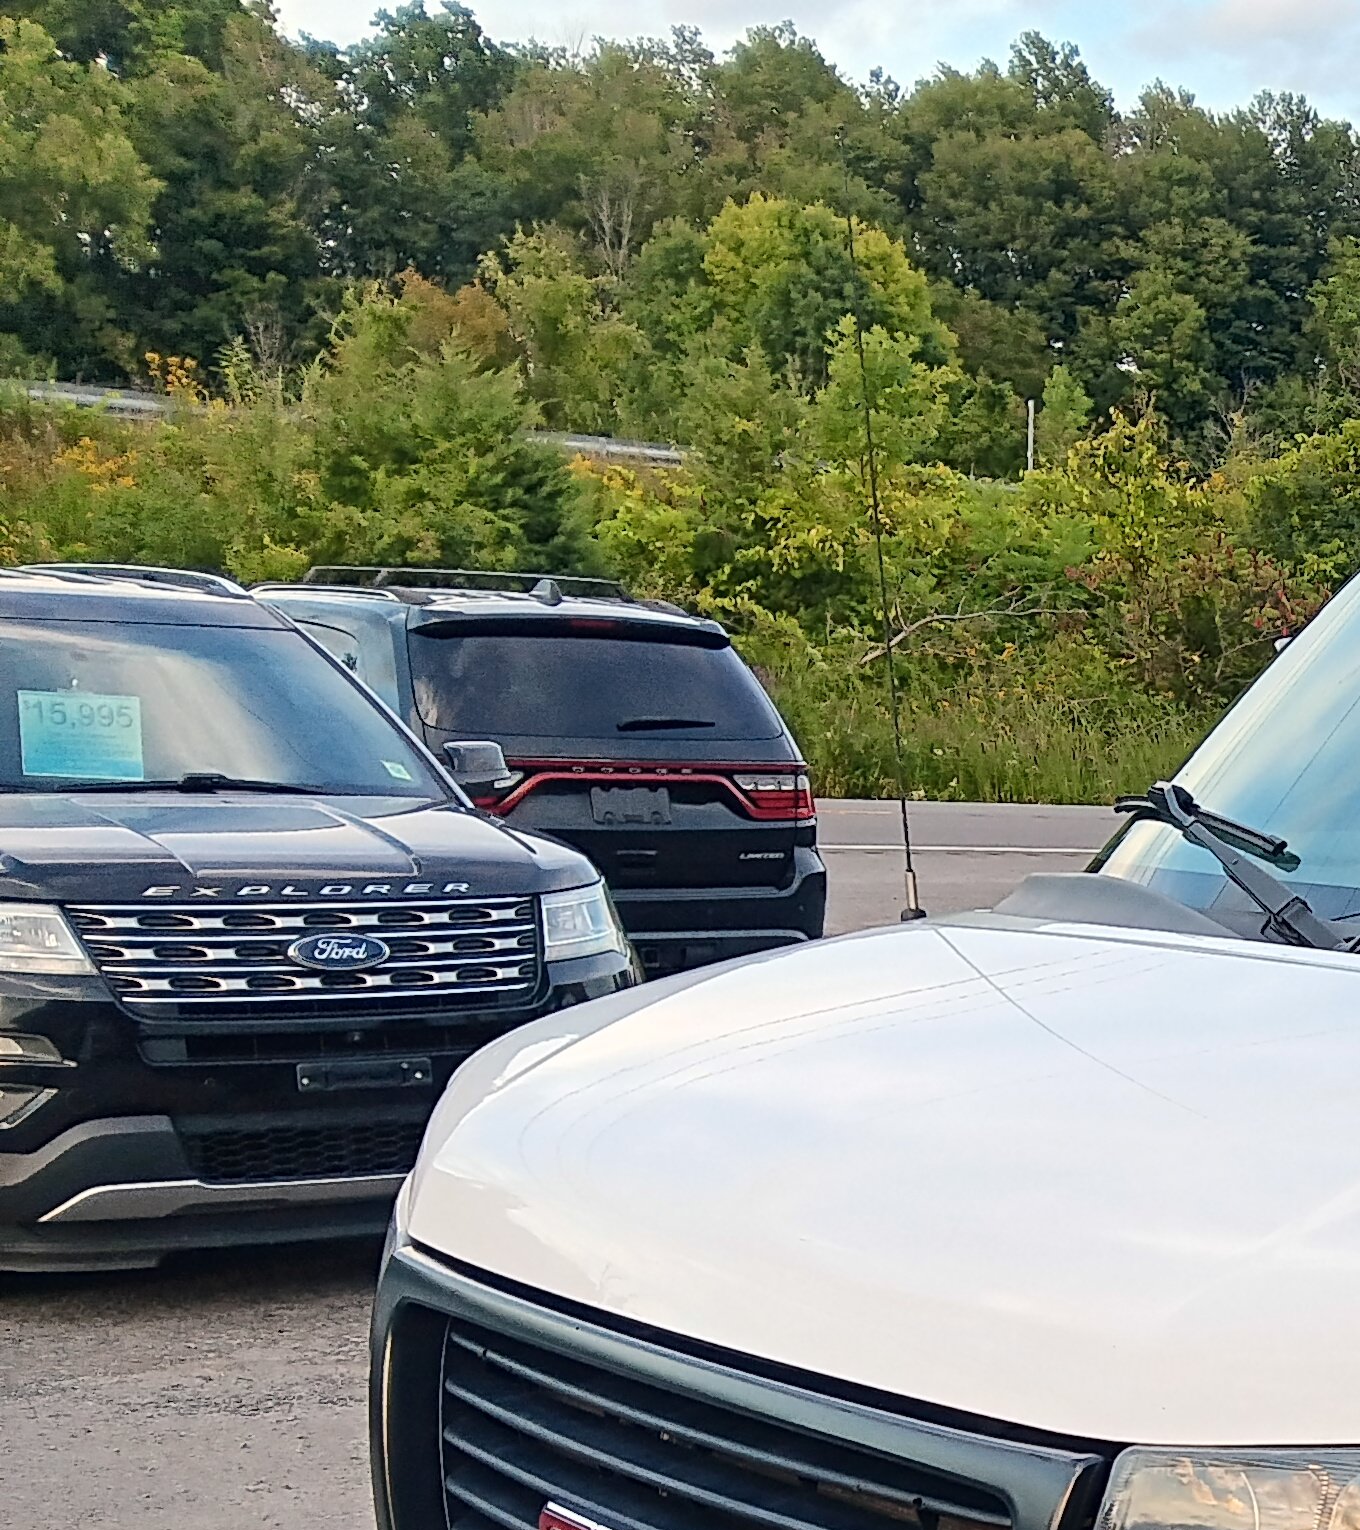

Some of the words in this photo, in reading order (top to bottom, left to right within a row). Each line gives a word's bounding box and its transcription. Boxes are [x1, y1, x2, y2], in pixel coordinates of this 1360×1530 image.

[571, 766, 692, 777] DODGE
[142, 881, 472, 898] EXPLORER
[313, 938, 368, 961] Ford
